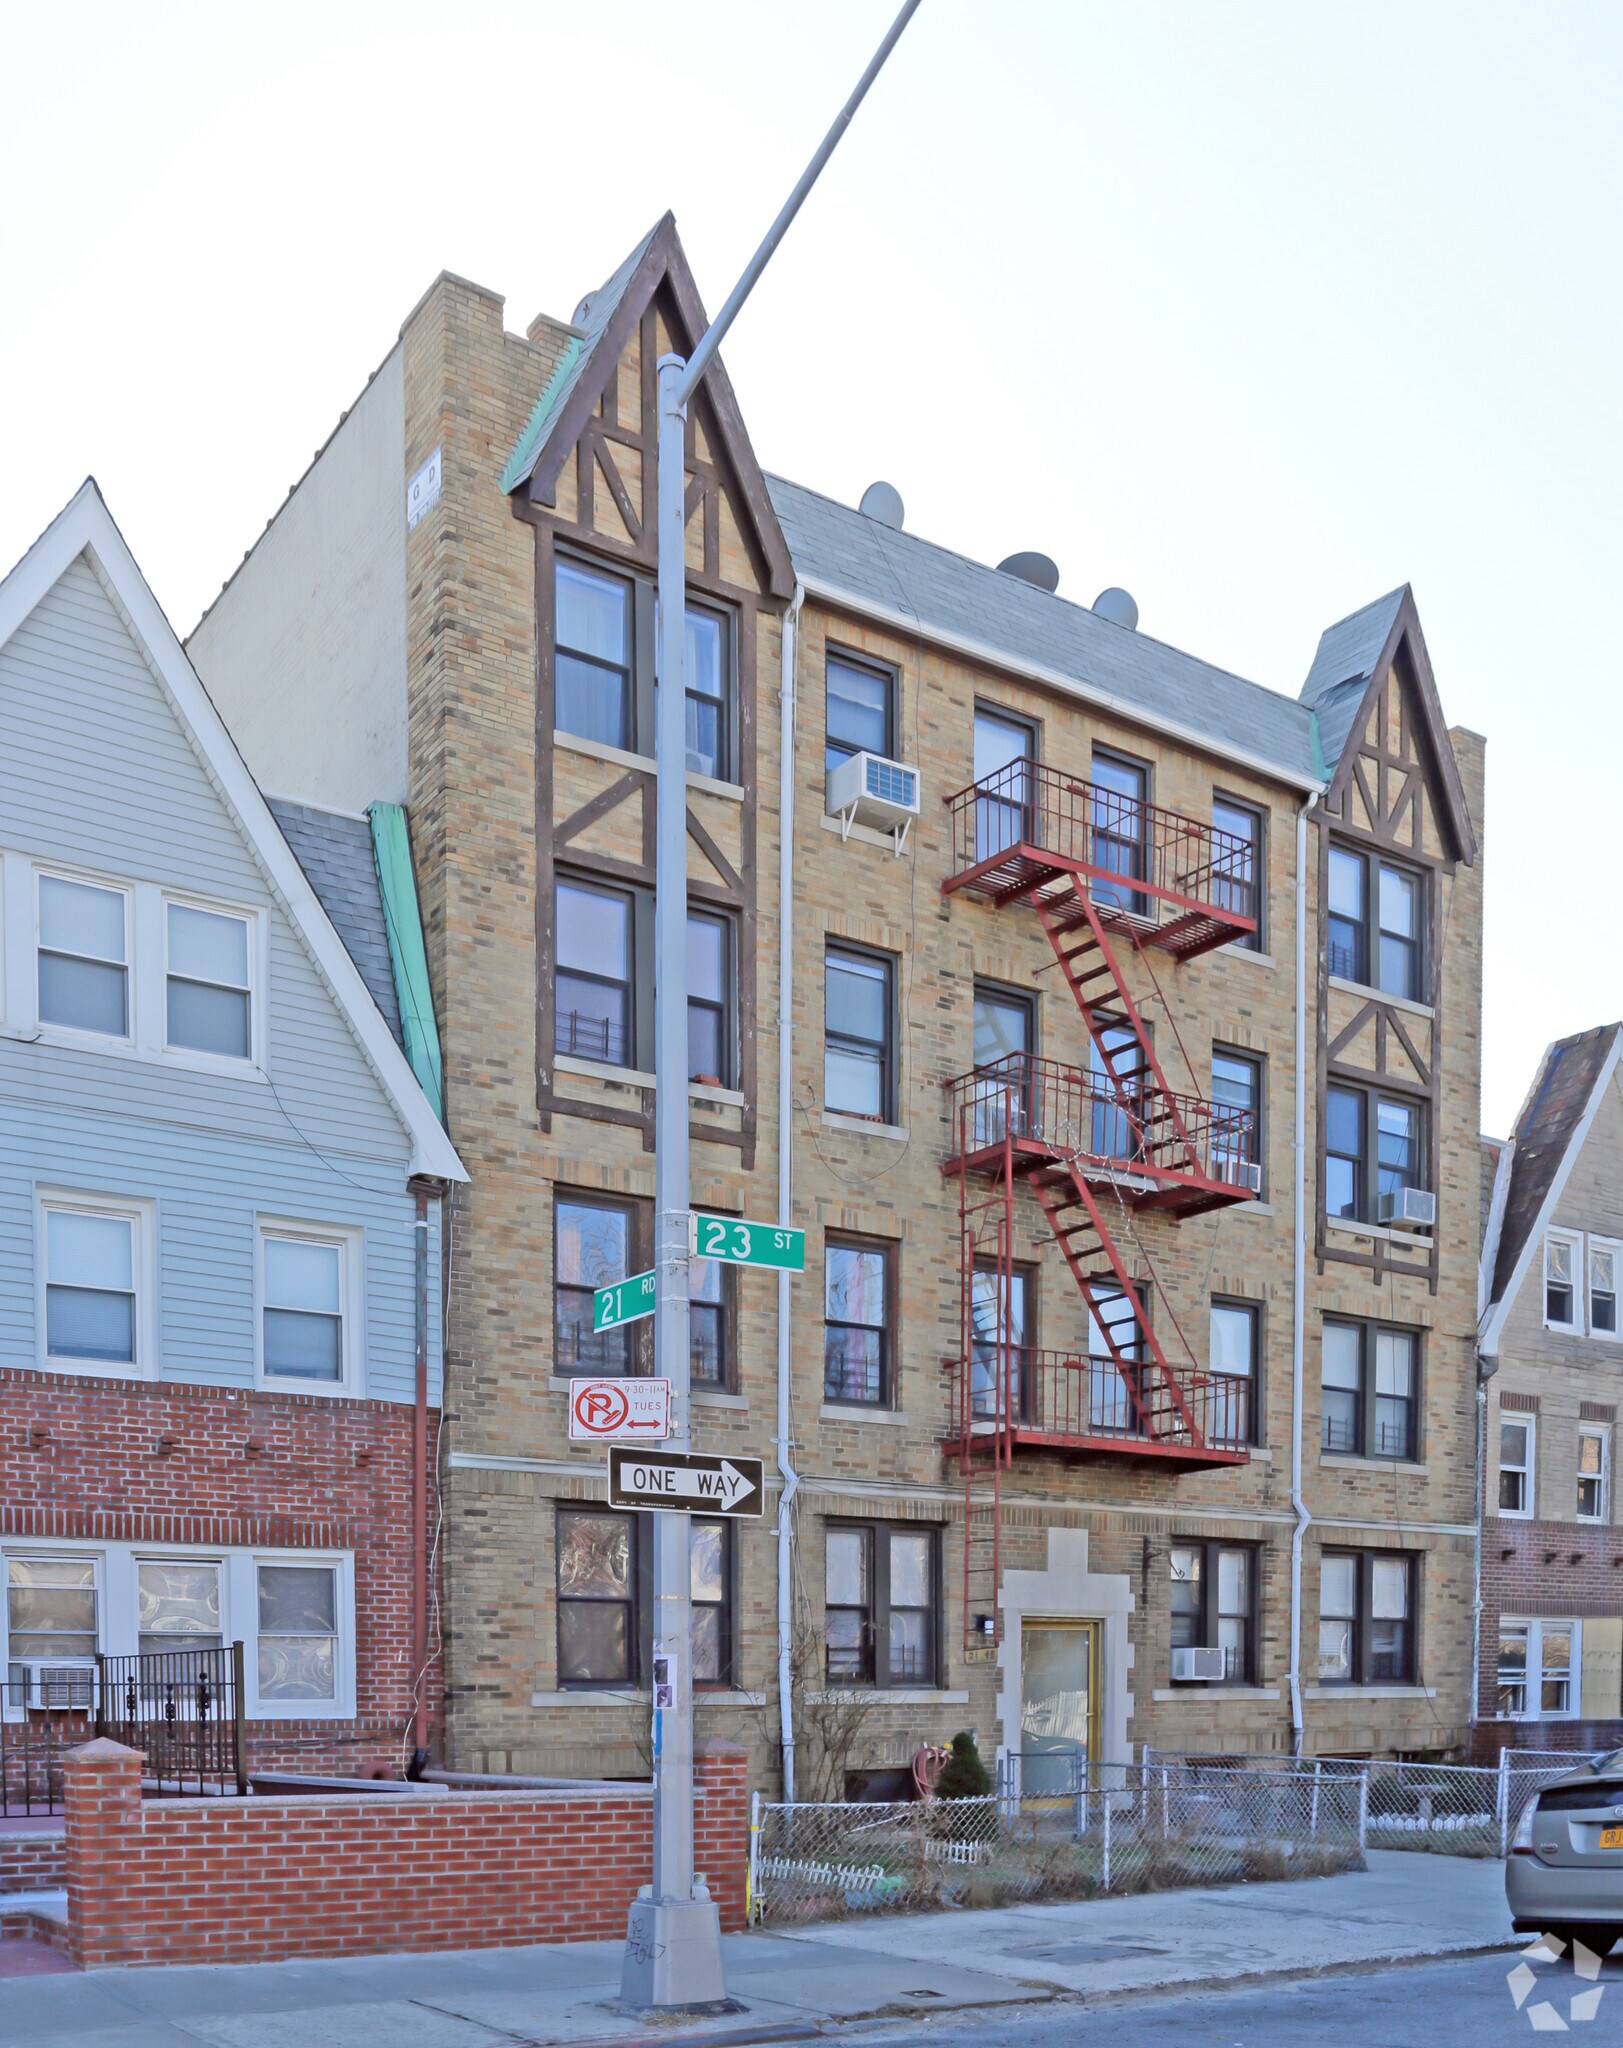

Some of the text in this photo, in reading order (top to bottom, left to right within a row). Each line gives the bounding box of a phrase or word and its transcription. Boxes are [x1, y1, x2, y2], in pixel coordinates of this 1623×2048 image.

[705, 1221, 793, 1259] 23 ST
[601, 1276, 656, 1325] 21 RD
[633, 1401, 662, 1411] TUES
[633, 1467, 741, 1497] ONE WAY
